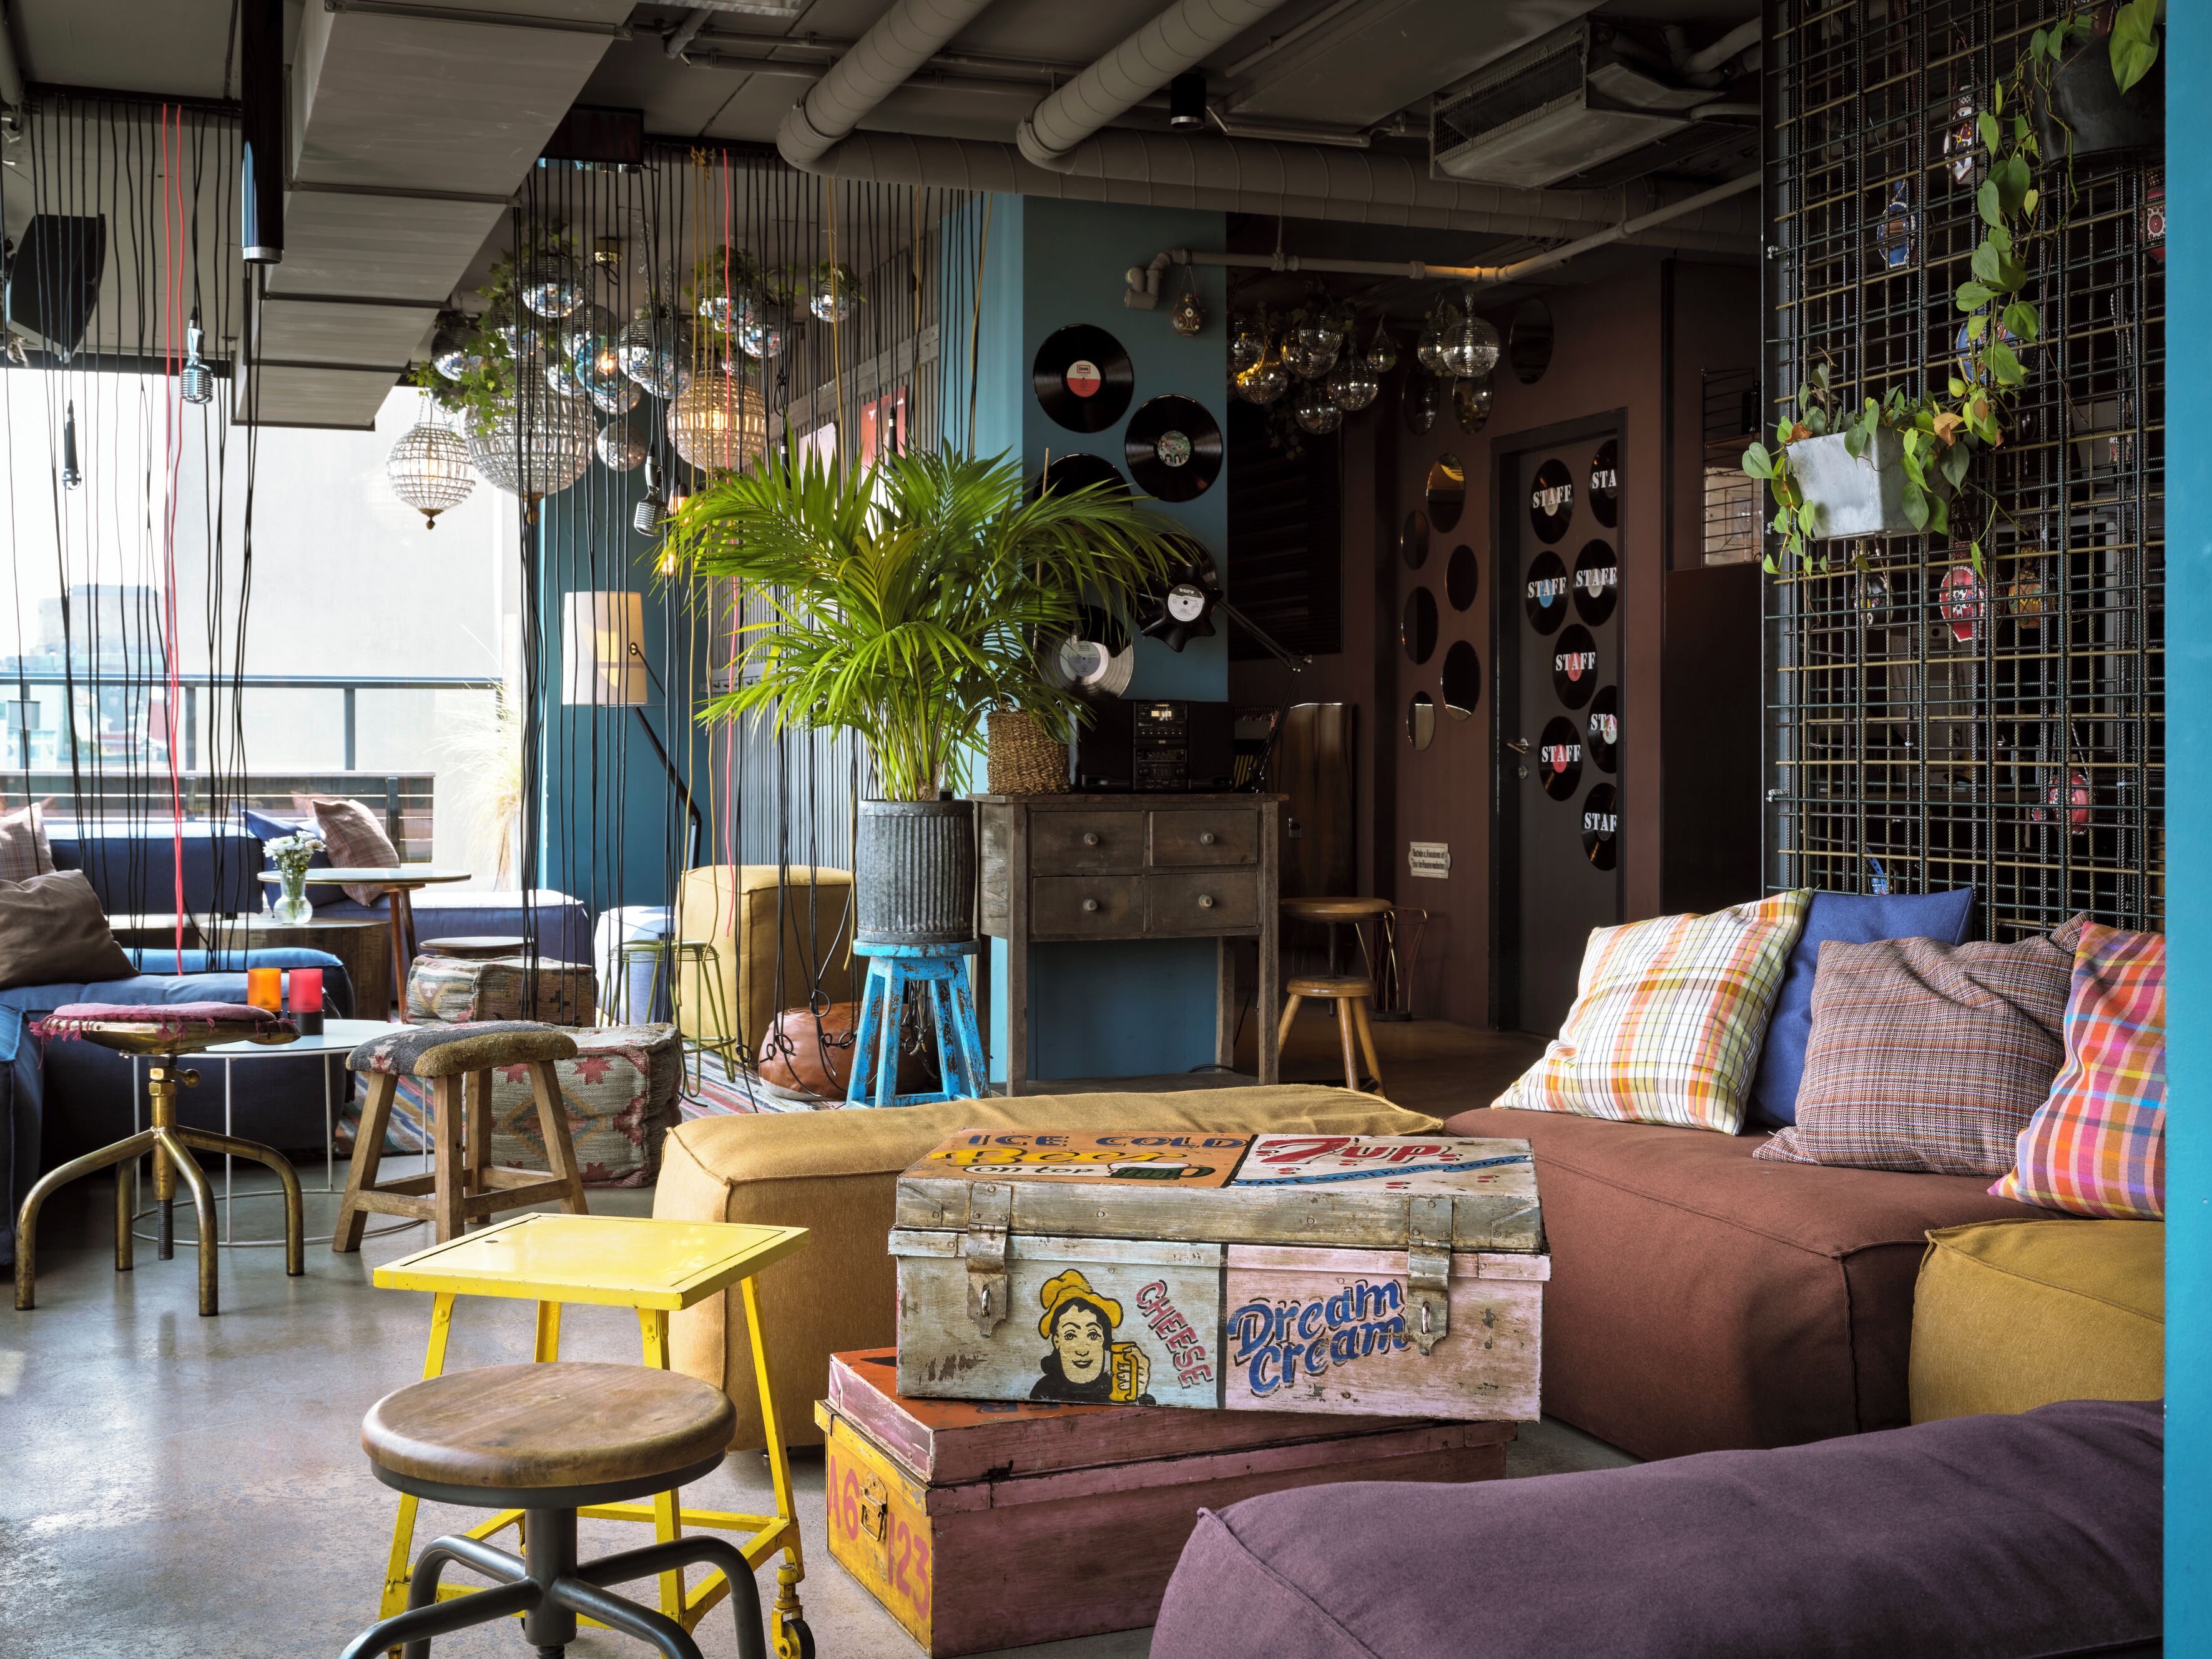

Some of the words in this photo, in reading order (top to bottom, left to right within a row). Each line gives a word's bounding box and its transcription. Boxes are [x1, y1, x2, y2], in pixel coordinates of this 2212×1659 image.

[1591, 469, 1617, 489] STA
[1533, 485, 1571, 508] STAFF
[1575, 567, 1617, 587] STAFF
[1528, 577, 1566, 598] STAFF
[1555, 652, 1596, 671] STAFF
[1590, 714, 1615, 731] STA
[1541, 744, 1581, 762] STAFF
[967, 1135, 1071, 1146] ICE
[1094, 1136, 1249, 1149] COLD
[929, 1146, 1189, 1166] Beer
[1457, 1156, 1518, 1169] TODAY
[973, 1165, 1024, 1174] on
[1030, 1165, 1095, 1175] top
[1227, 1279, 1406, 1367] Dream
[1136, 1279, 1214, 1389] CHEESE
[1247, 1314, 1412, 1398] Cream
[828, 1454, 860, 1541] A6
[887, 1512, 930, 1621] 123
